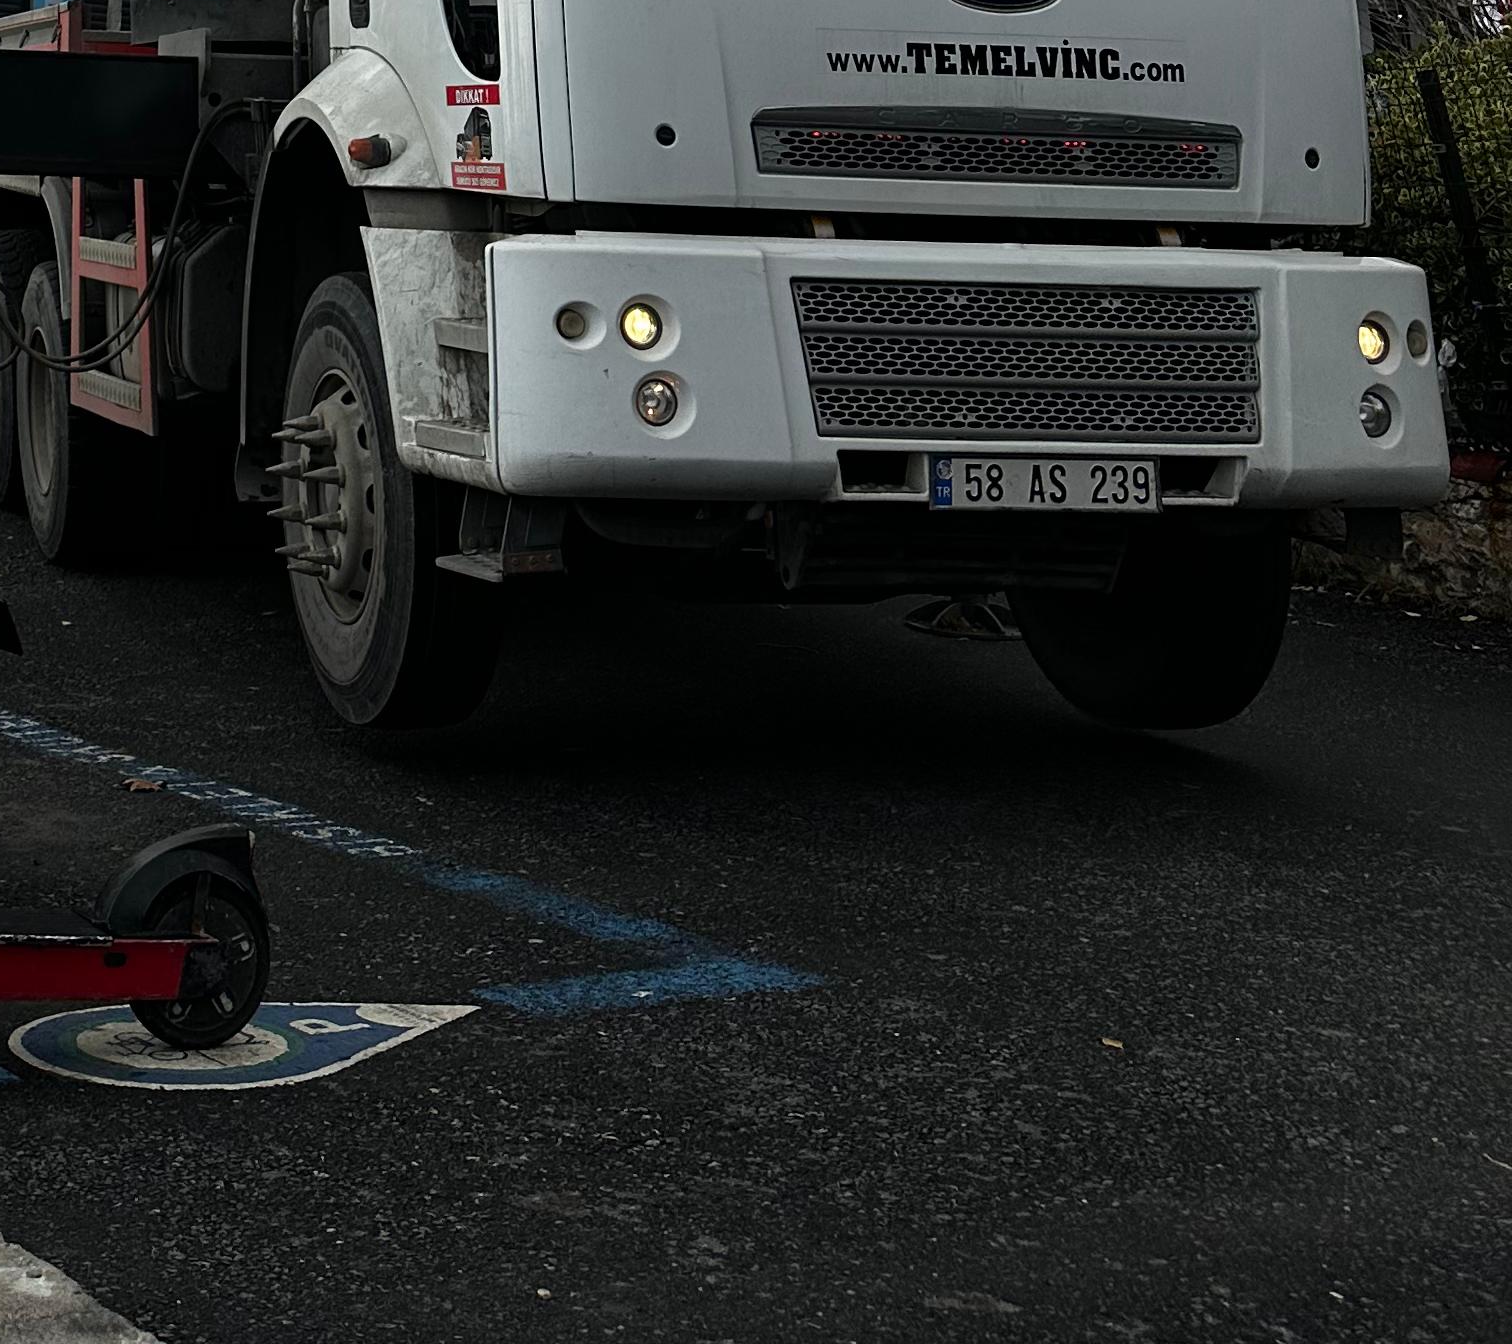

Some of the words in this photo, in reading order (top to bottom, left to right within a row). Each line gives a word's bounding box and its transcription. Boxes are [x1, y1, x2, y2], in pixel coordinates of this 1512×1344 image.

[936, 486, 950, 498] TR
[965, 464, 1004, 502] 58
[1029, 464, 1067, 504] AS
[1090, 465, 1150, 504] 239
